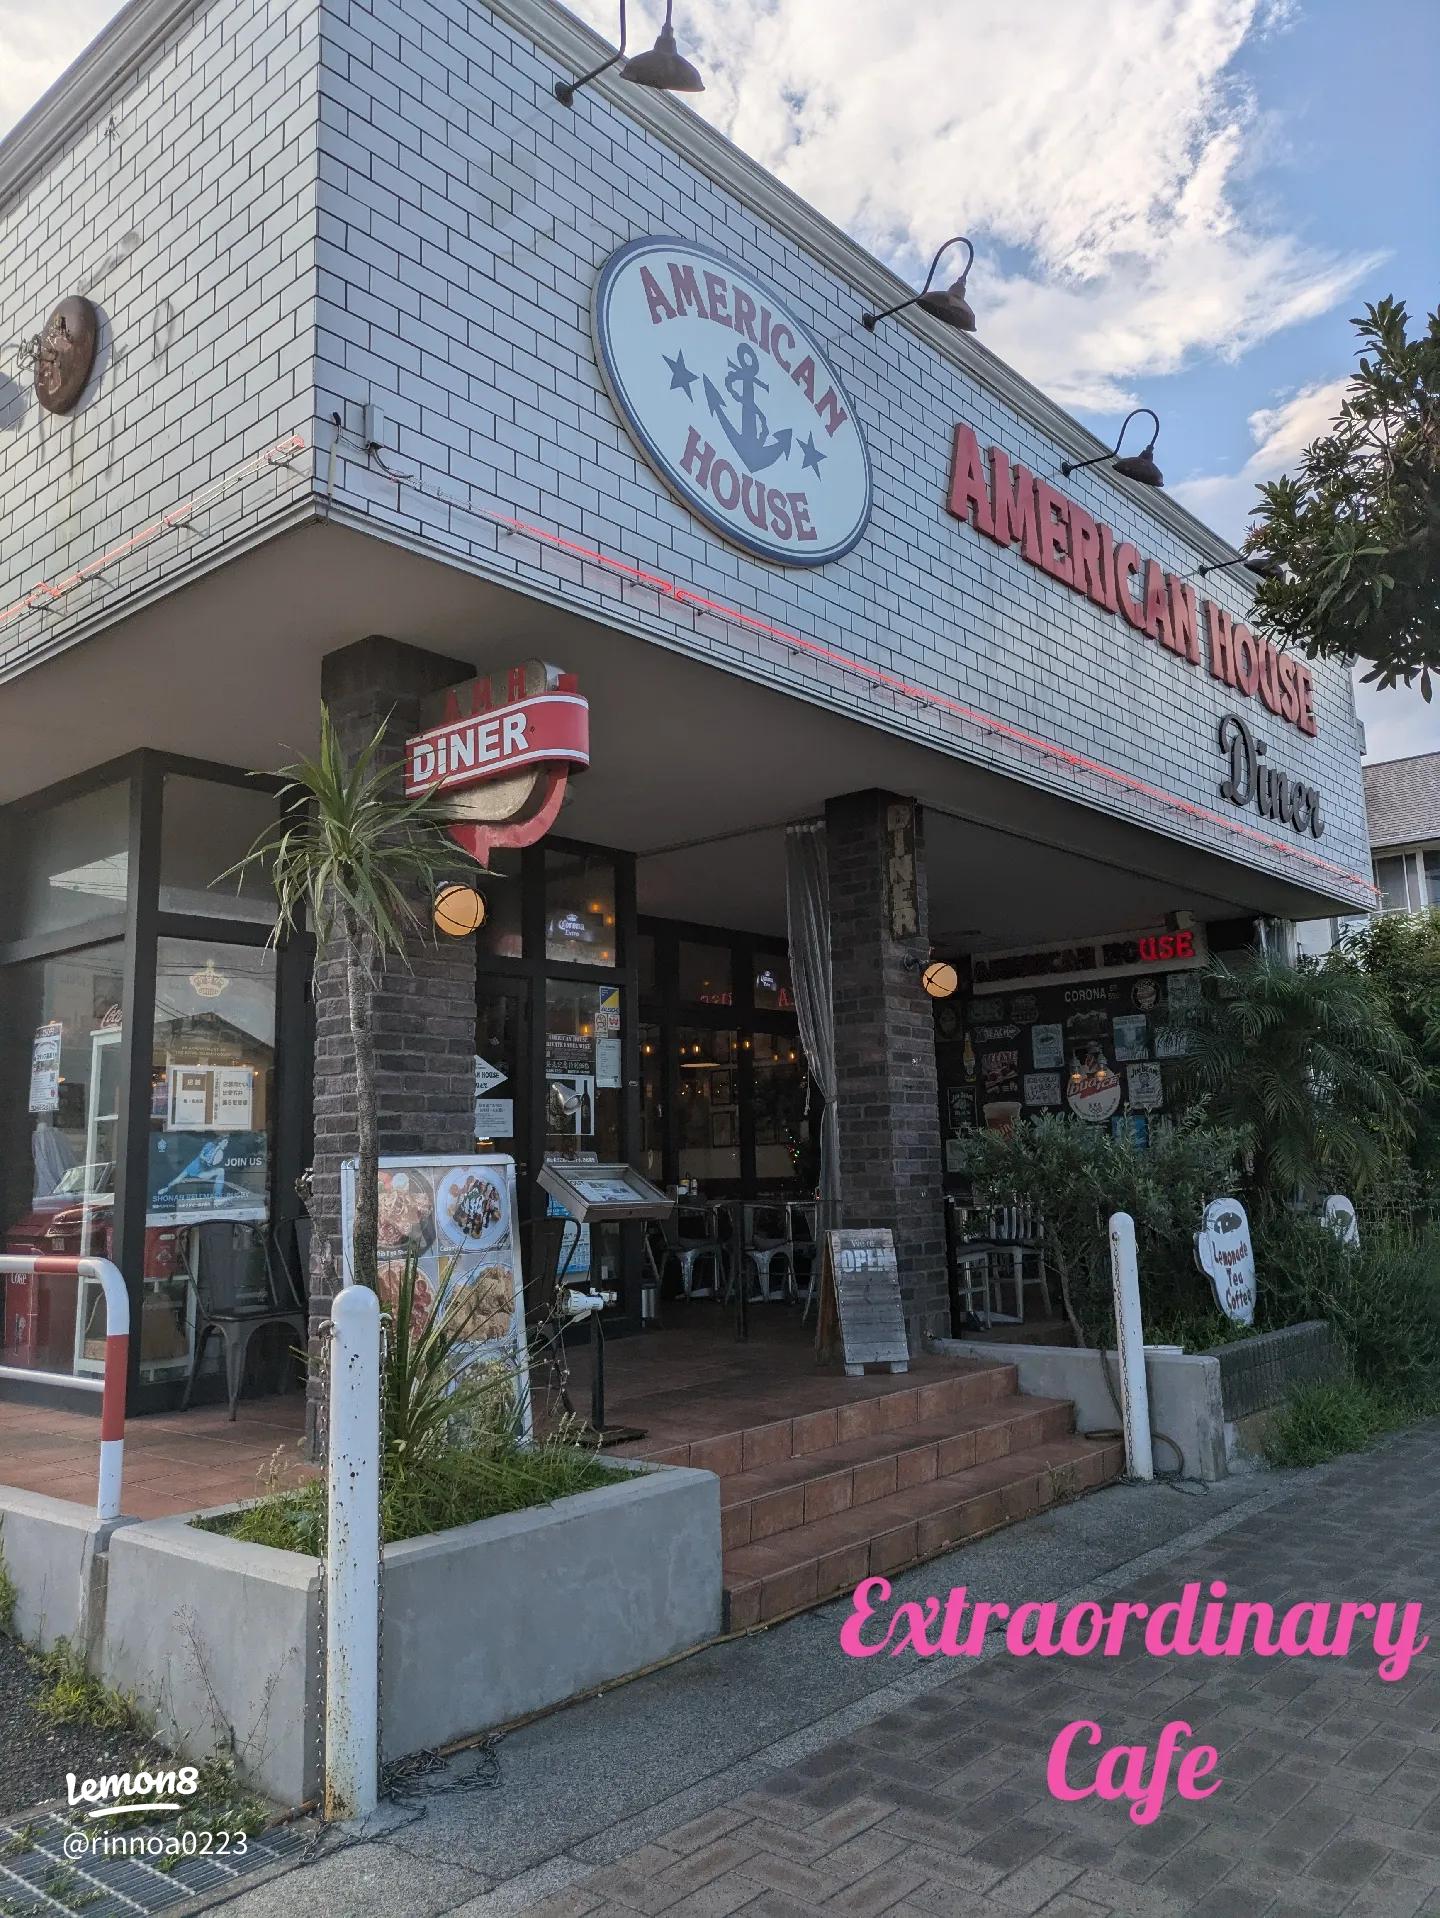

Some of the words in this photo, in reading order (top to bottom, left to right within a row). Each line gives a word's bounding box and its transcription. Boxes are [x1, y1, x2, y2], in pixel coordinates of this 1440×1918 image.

[639, 262, 848, 438] AMERICAN
[679, 425, 818, 541] HOUSE
[946, 422, 1201, 666] AMERICAN
[1203, 600, 1319, 738] HOUSE
[413, 712, 529, 782] DINER
[1218, 713, 1325, 839] Diner
[558, 919, 585, 931] Corona
[1064, 986, 1106, 1002] CORONA
[224, 1158, 247, 1167] JOIN
[249, 1157, 262, 1166] US
[841, 1248, 893, 1273] OPEN
[1211, 1240, 1249, 1266] Lemonade
[1226, 1268, 1244, 1287] Tea
[1225, 1287, 1252, 1311] Coffee
